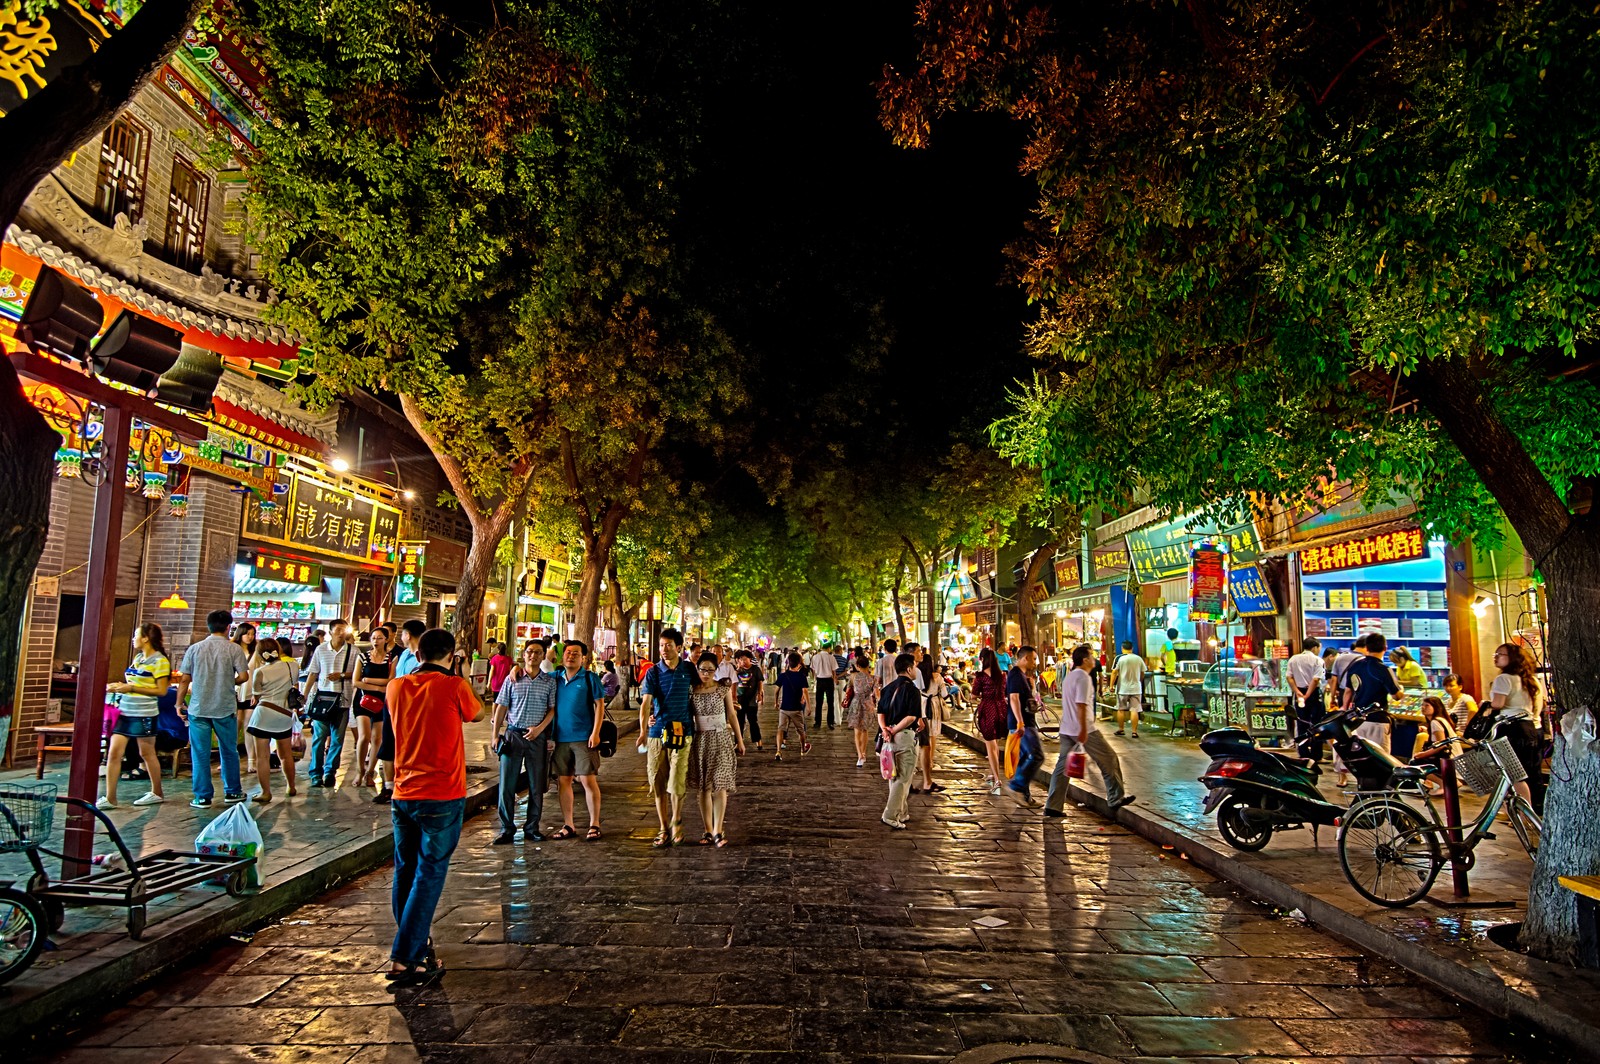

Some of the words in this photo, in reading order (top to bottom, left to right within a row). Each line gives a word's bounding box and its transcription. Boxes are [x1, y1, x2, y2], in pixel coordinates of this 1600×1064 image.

[293, 501, 365, 549] 龍須糖
[1196, 551, 1221, 612] 军军绿豆糕
